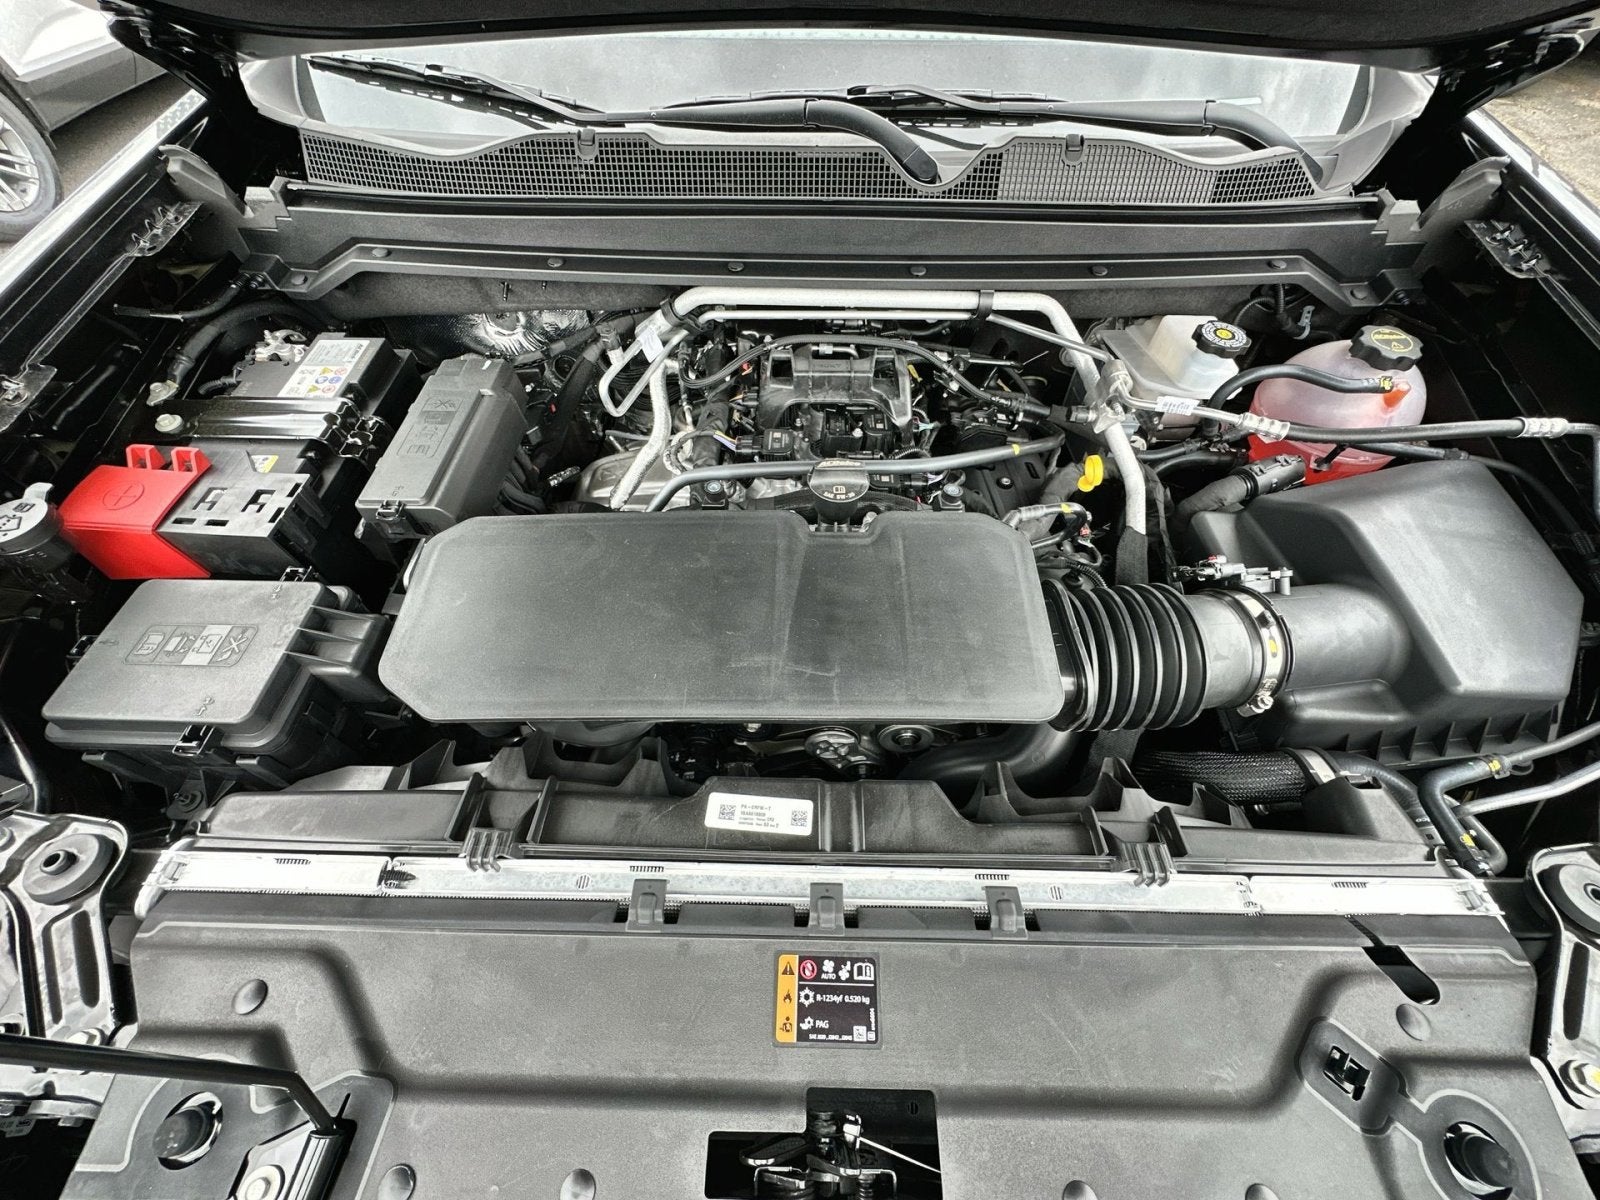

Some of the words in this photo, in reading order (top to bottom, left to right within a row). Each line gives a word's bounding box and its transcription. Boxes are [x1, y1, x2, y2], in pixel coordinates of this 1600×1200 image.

[816, 994, 843, 1004] R-1234yf
[862, 996, 870, 1004] kg
[815, 1020, 829, 1029] PAG
